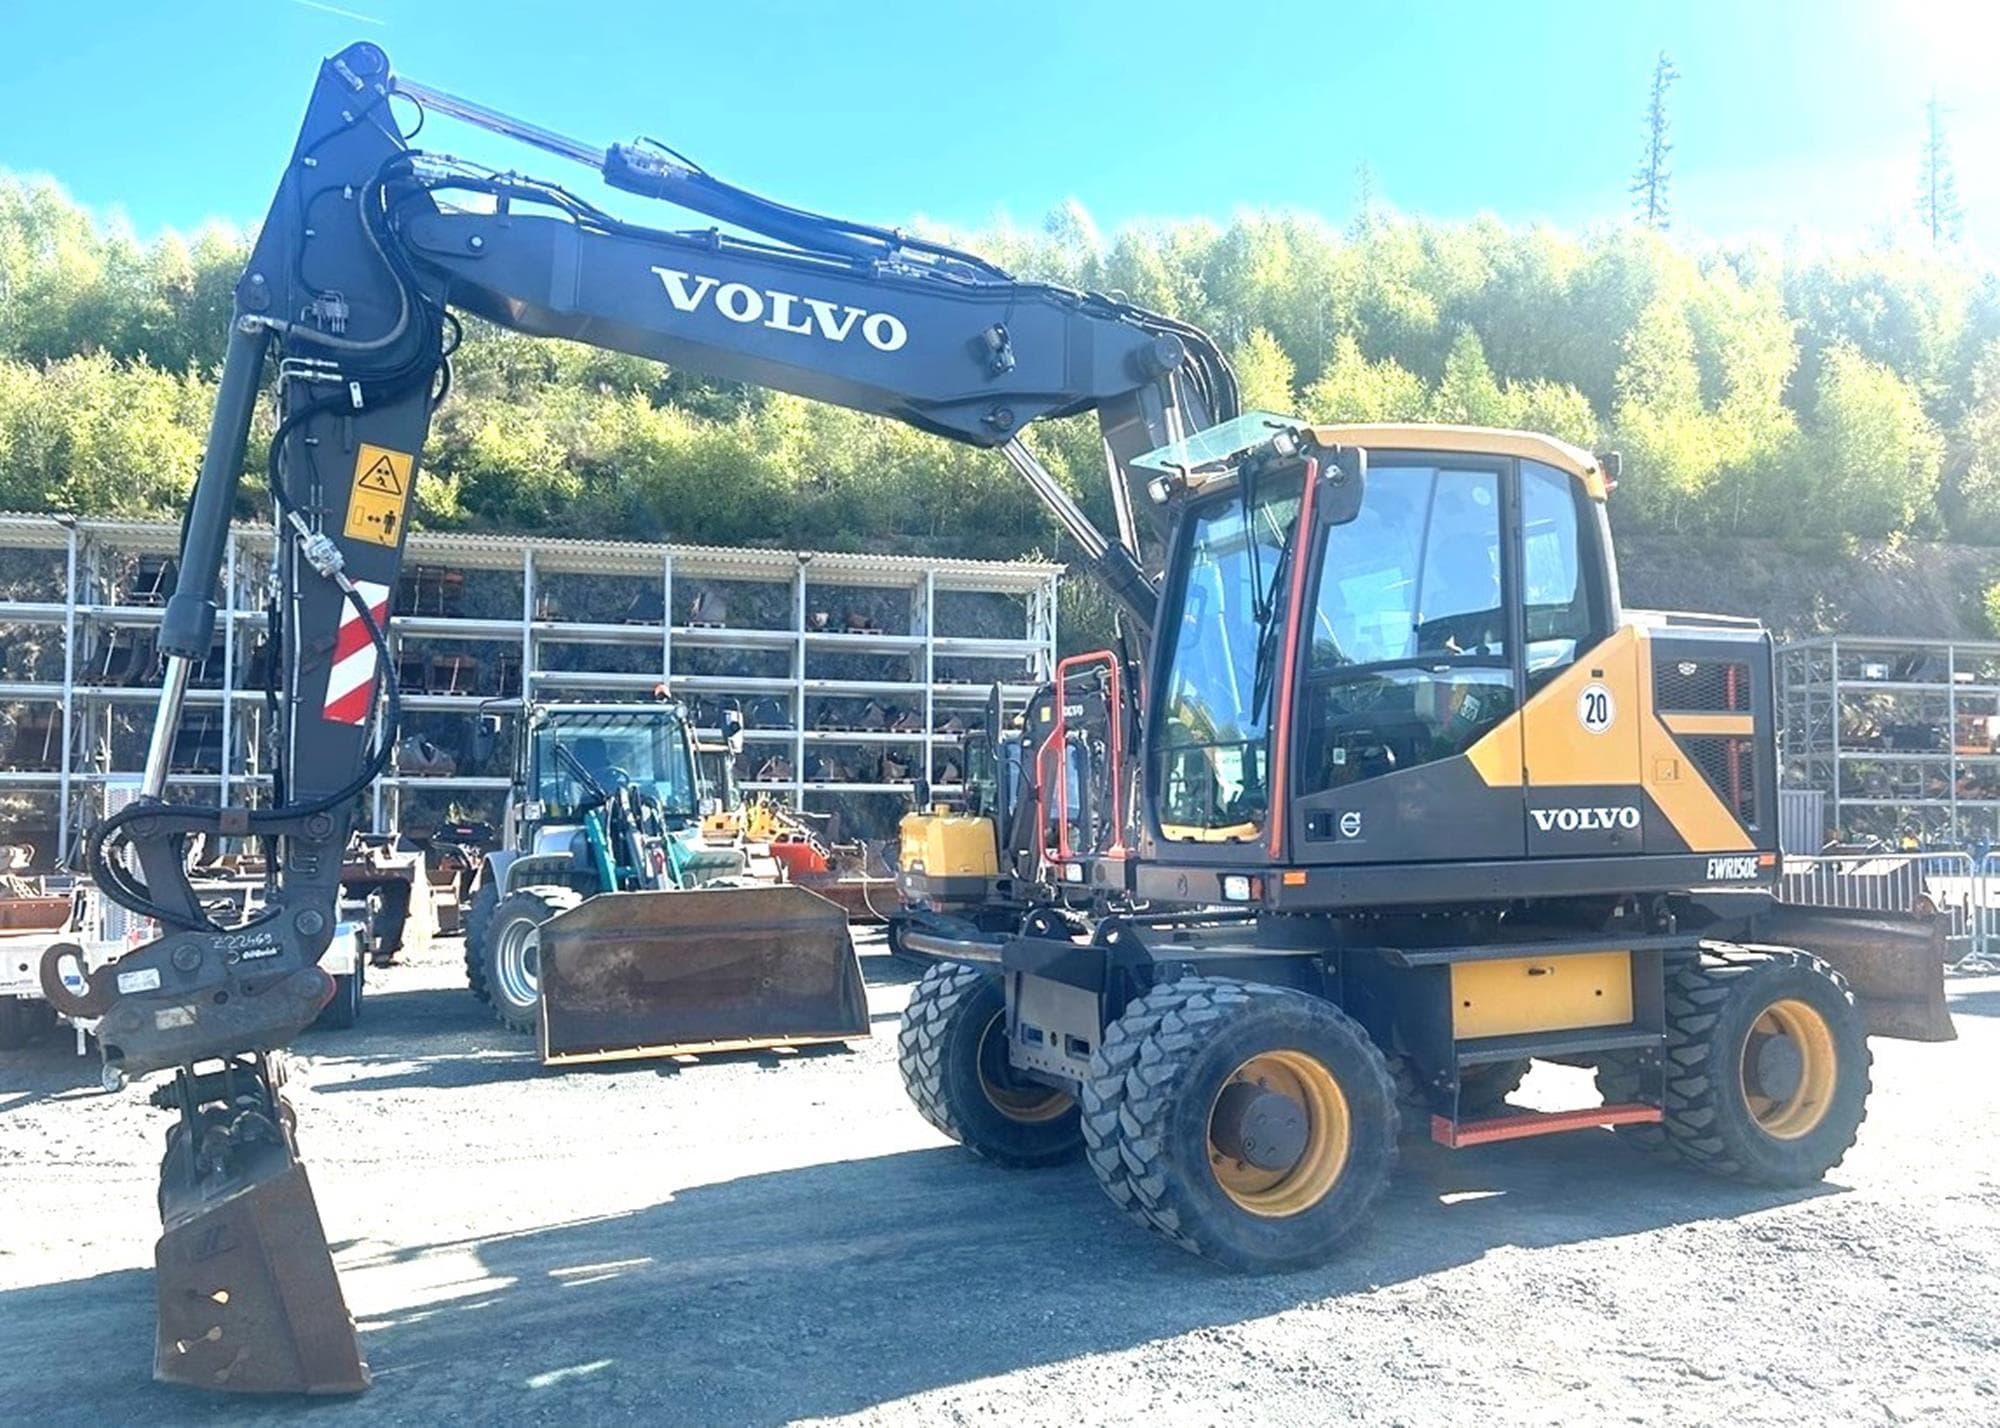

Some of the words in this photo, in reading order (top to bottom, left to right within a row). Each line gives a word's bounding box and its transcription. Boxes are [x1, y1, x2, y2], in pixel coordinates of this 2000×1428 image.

[651, 266, 907, 351] VOLVO
[1585, 693, 1607, 723] 20
[1530, 806, 1640, 831] VOLVO
[1706, 857, 1758, 880] EWR150E
